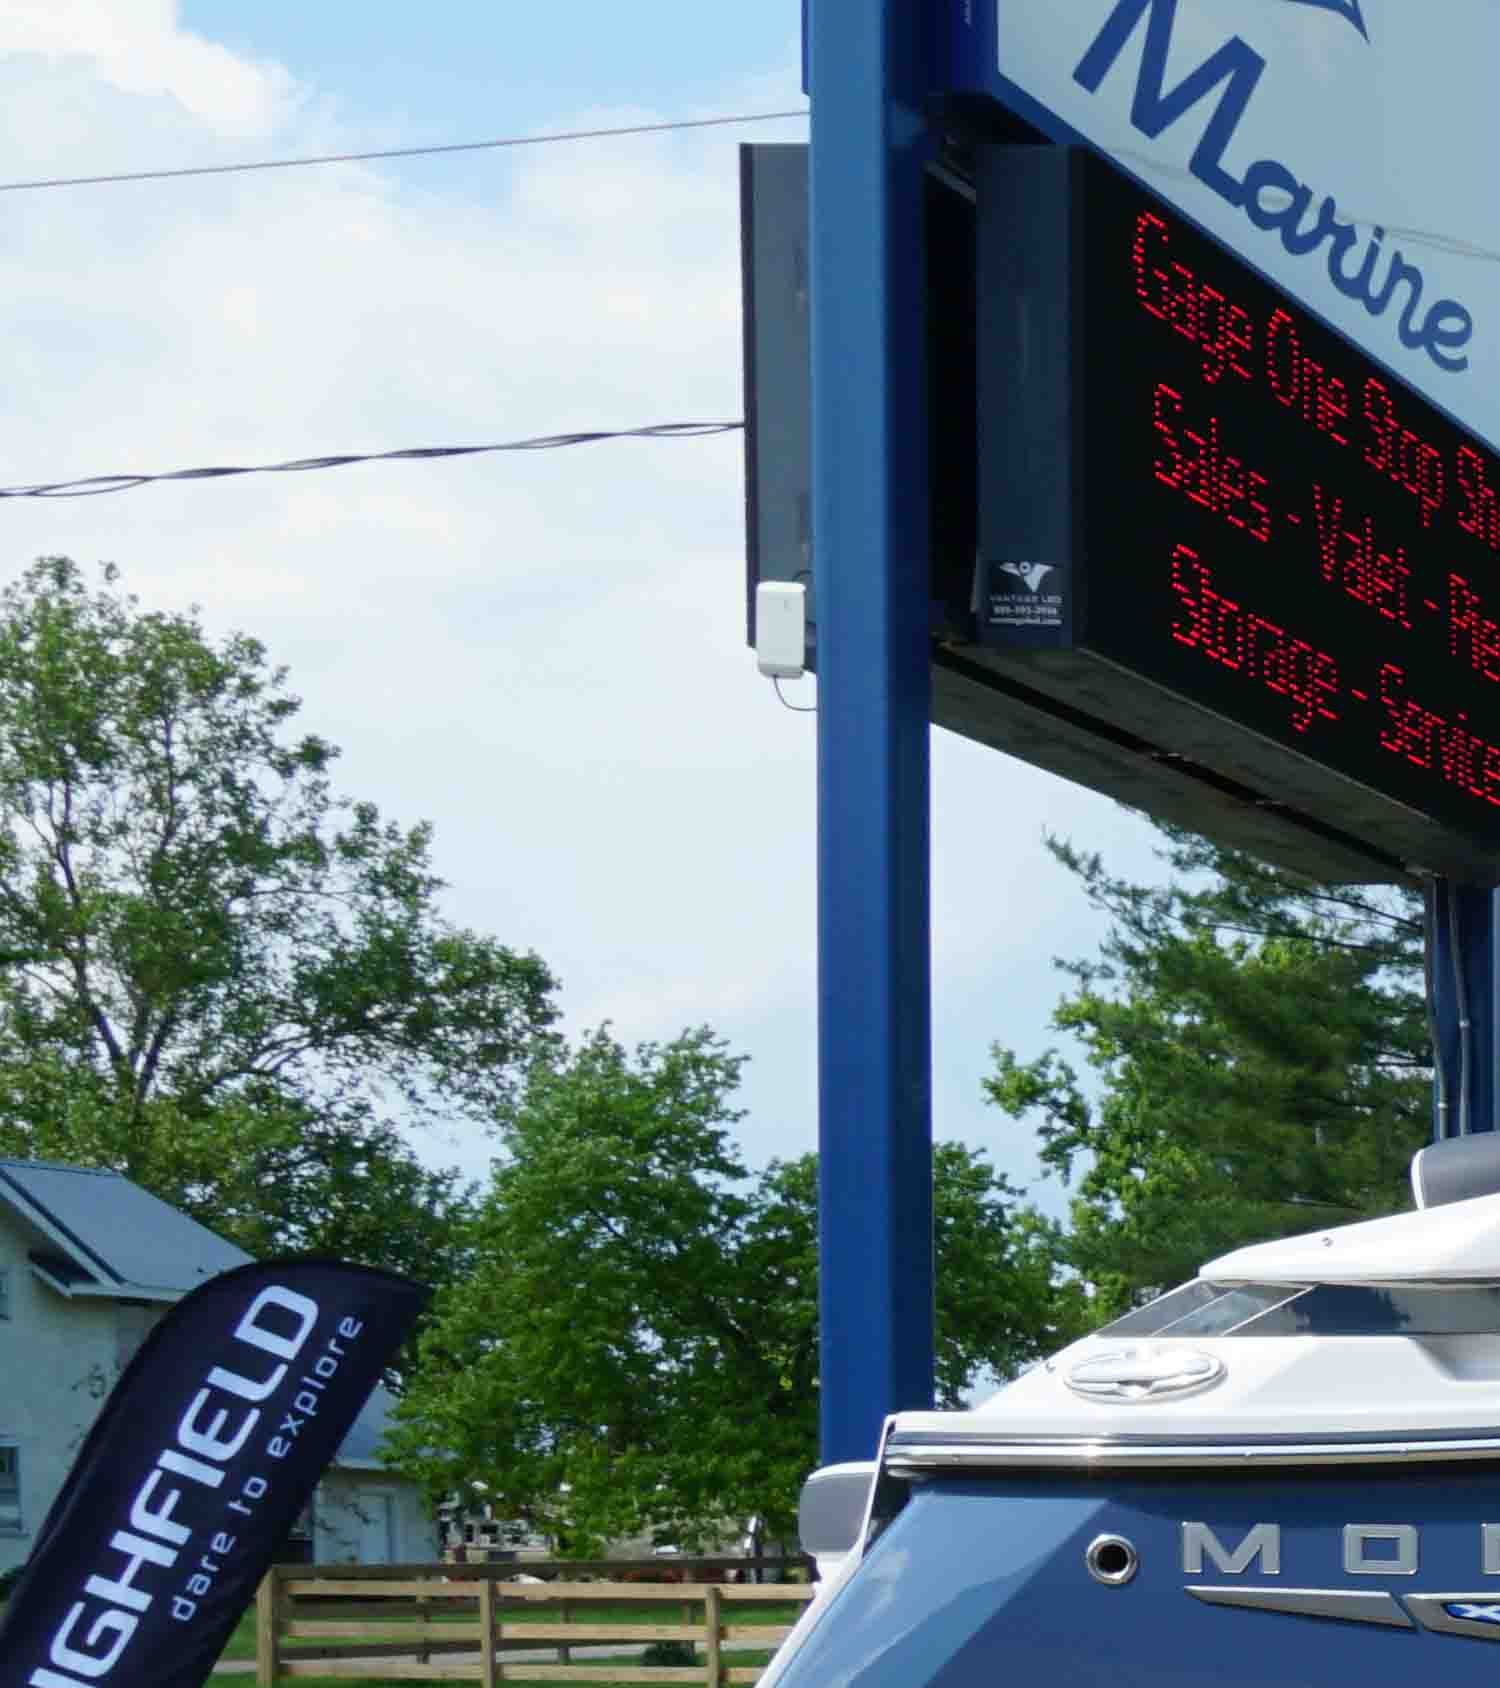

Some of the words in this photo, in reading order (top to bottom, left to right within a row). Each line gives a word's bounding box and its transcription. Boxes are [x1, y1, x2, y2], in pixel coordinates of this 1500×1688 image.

[1072, 0, 1473, 373] Marine
[1132, 211, 1253, 384] Gage
[1265, 307, 1349, 446] One
[1364, 376, 1444, 528] Stop
[1153, 382, 1272, 543] Sales
[1313, 481, 1413, 630] Valet
[1170, 542, 1341, 734] Storage
[172, 1530, 237, 1623] dare
[227, 1476, 268, 1516] to
[266, 1315, 364, 1459] explore
